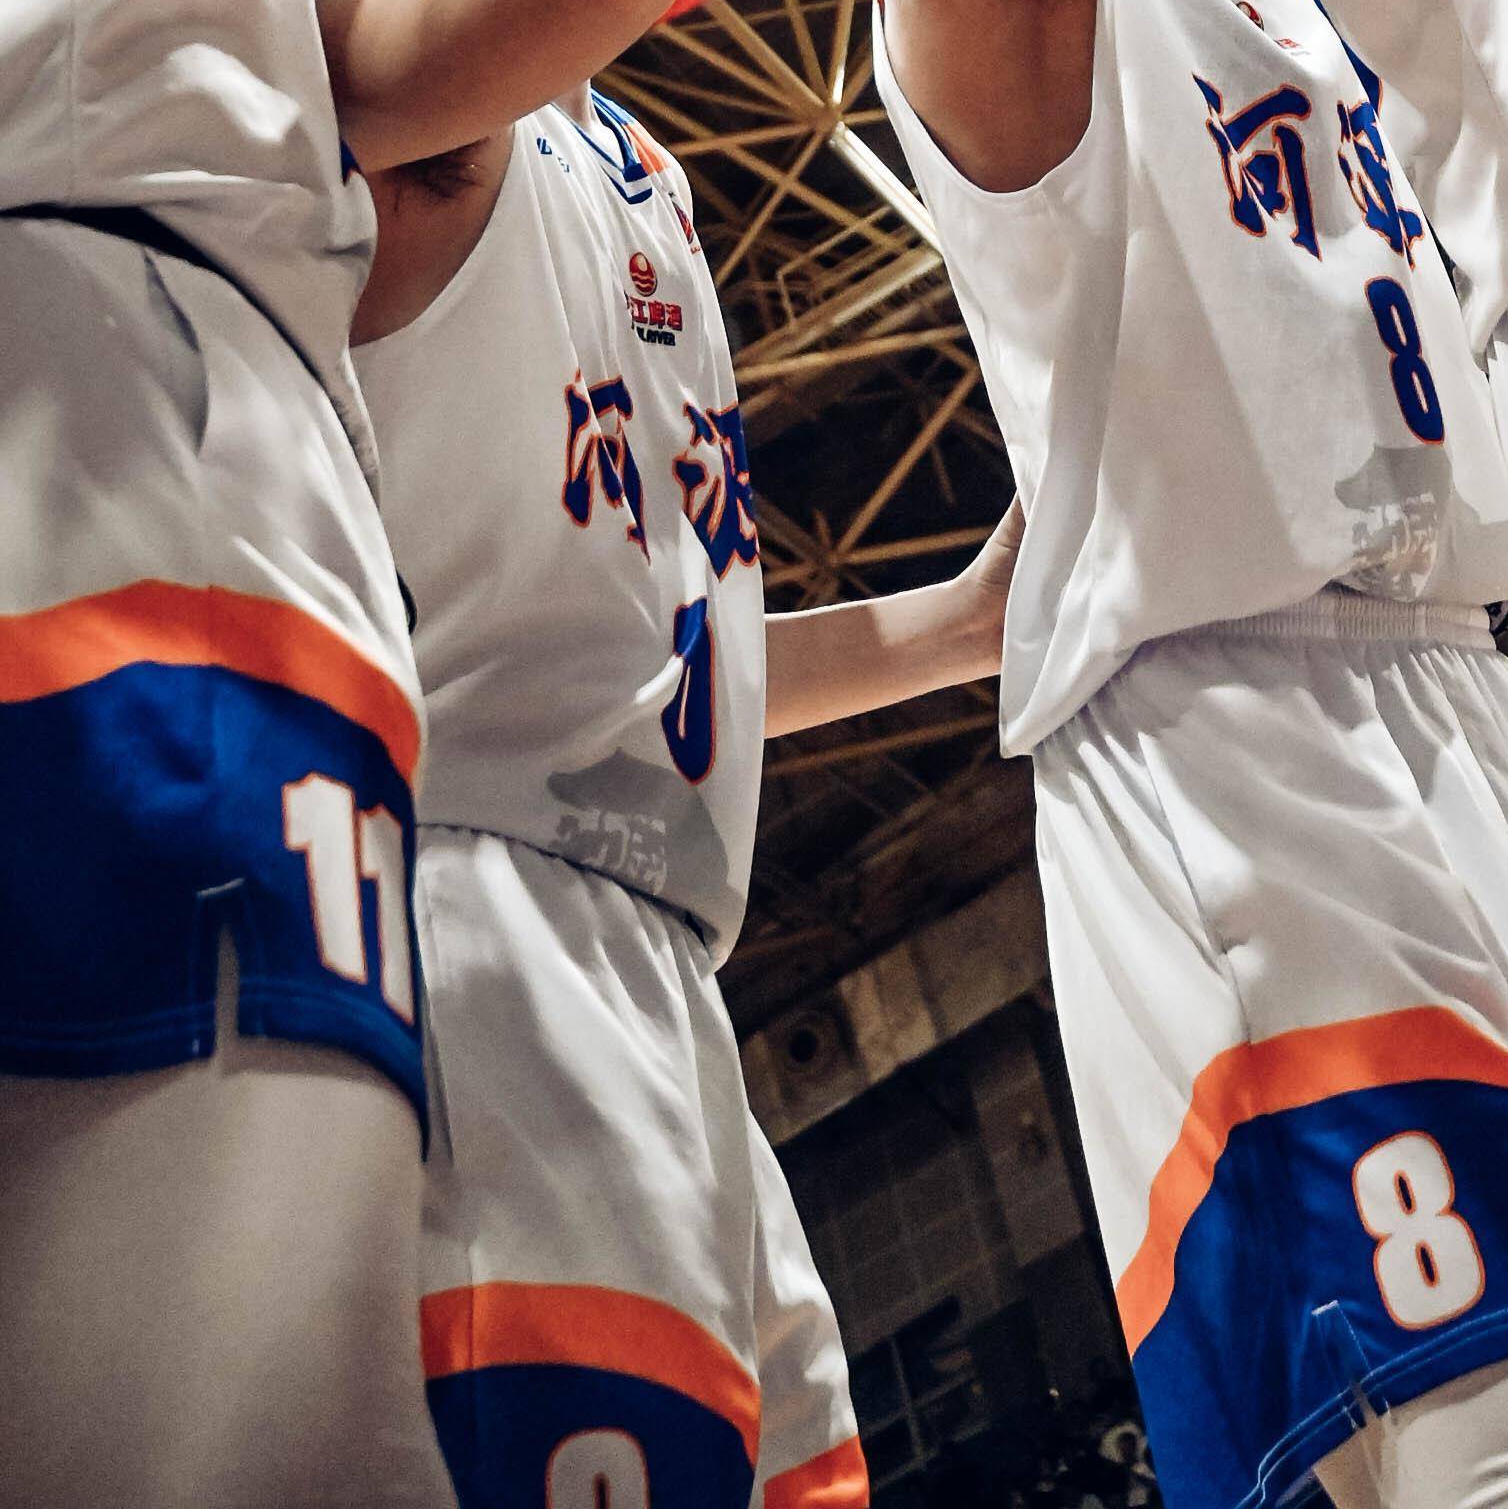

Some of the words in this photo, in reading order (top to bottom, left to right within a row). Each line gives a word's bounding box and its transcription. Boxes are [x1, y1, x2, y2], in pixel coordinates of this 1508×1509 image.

[624, 291, 683, 332] 江啤酒
[1363, 275, 1446, 446] 8
[280, 771, 416, 1028] 11
[1351, 1129, 1485, 1331] 8
